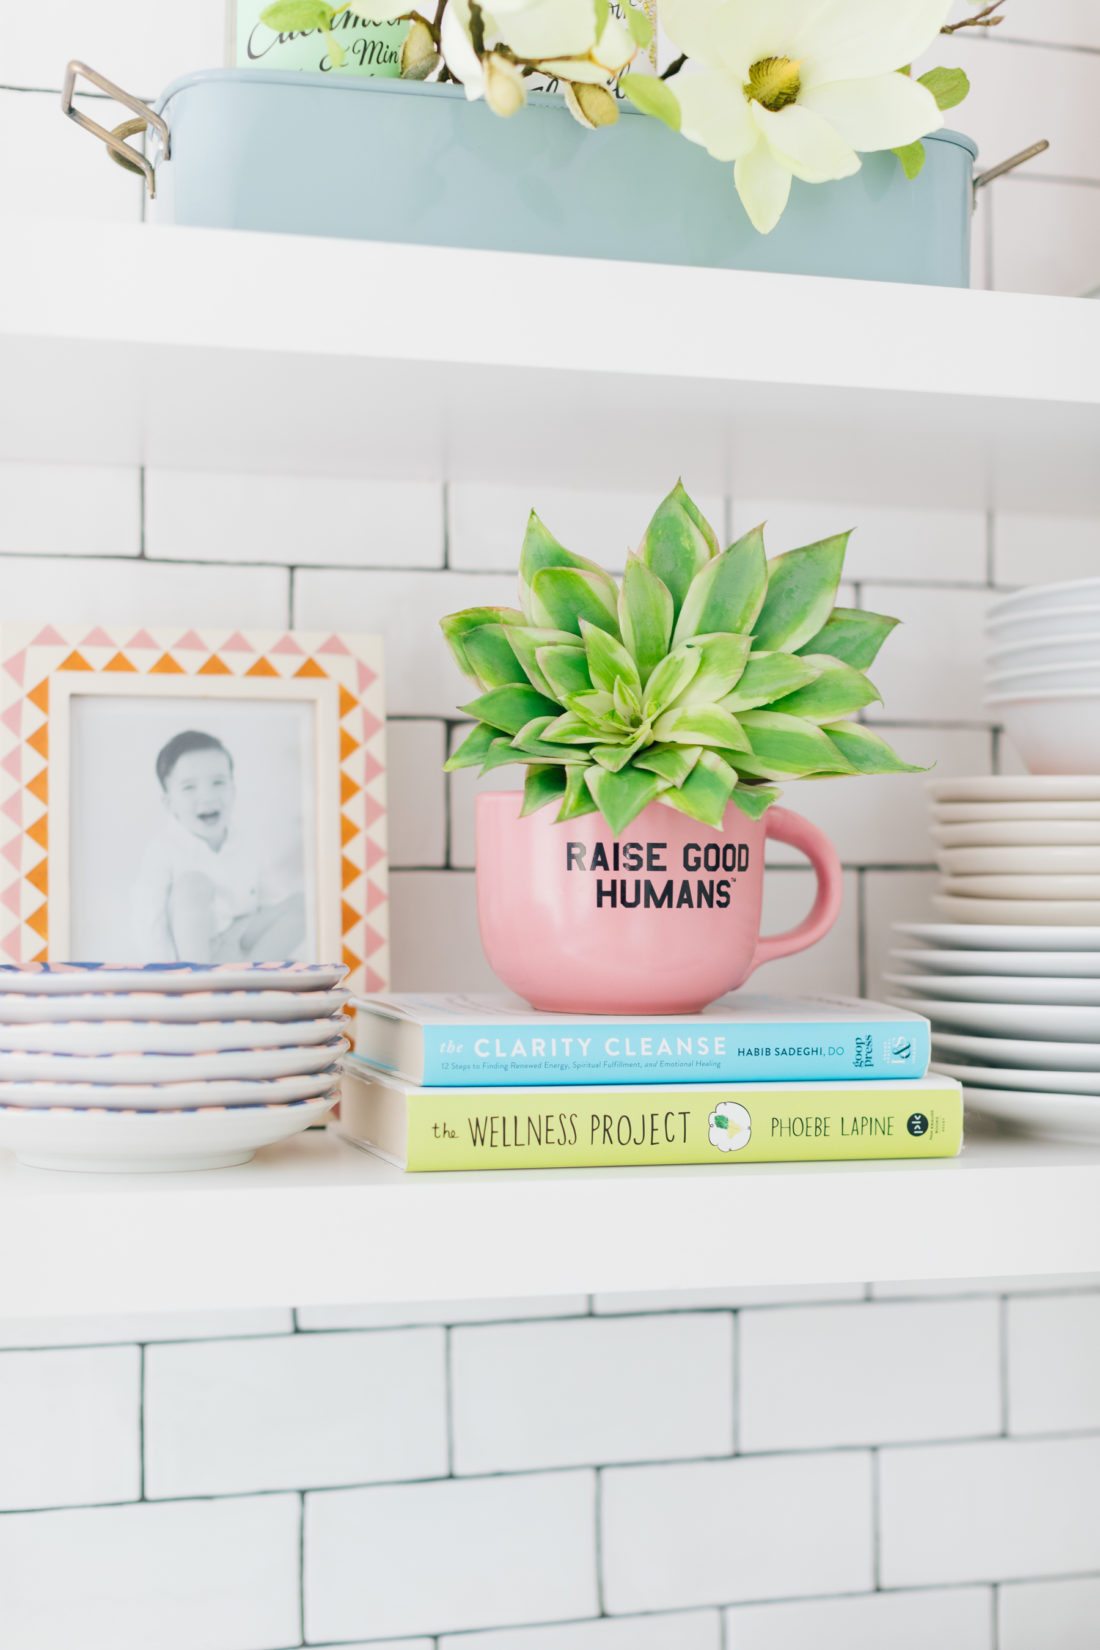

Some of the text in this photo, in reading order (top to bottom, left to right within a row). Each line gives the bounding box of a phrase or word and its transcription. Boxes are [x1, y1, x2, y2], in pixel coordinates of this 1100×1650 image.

[352, 38, 400, 66] Min
[566, 841, 749, 872] RAISE GOOD
[439, 1036, 845, 1058] the CLARITY CLEANSE HABIB SADEGHI, DO
[852, 1036, 865, 1068] goop
[864, 1034, 874, 1067] press
[441, 1062, 450, 1070] 12
[451, 1062, 471, 1071] Steps
[472, 1062, 481, 1070] to
[482, 1061, 509, 1071] Finding
[510, 1061, 542, 1069] Renewed
[544, 1060, 569, 1071] Energy,
[572, 1060, 601, 1070] Spiritual
[644, 1060, 658, 1068] and
[660, 1060, 694, 1068] Emotional
[695, 1059, 722, 1069] Healing
[431, 1111, 895, 1148] the WELLNESS PROJECT PHOEBE LAPINE
